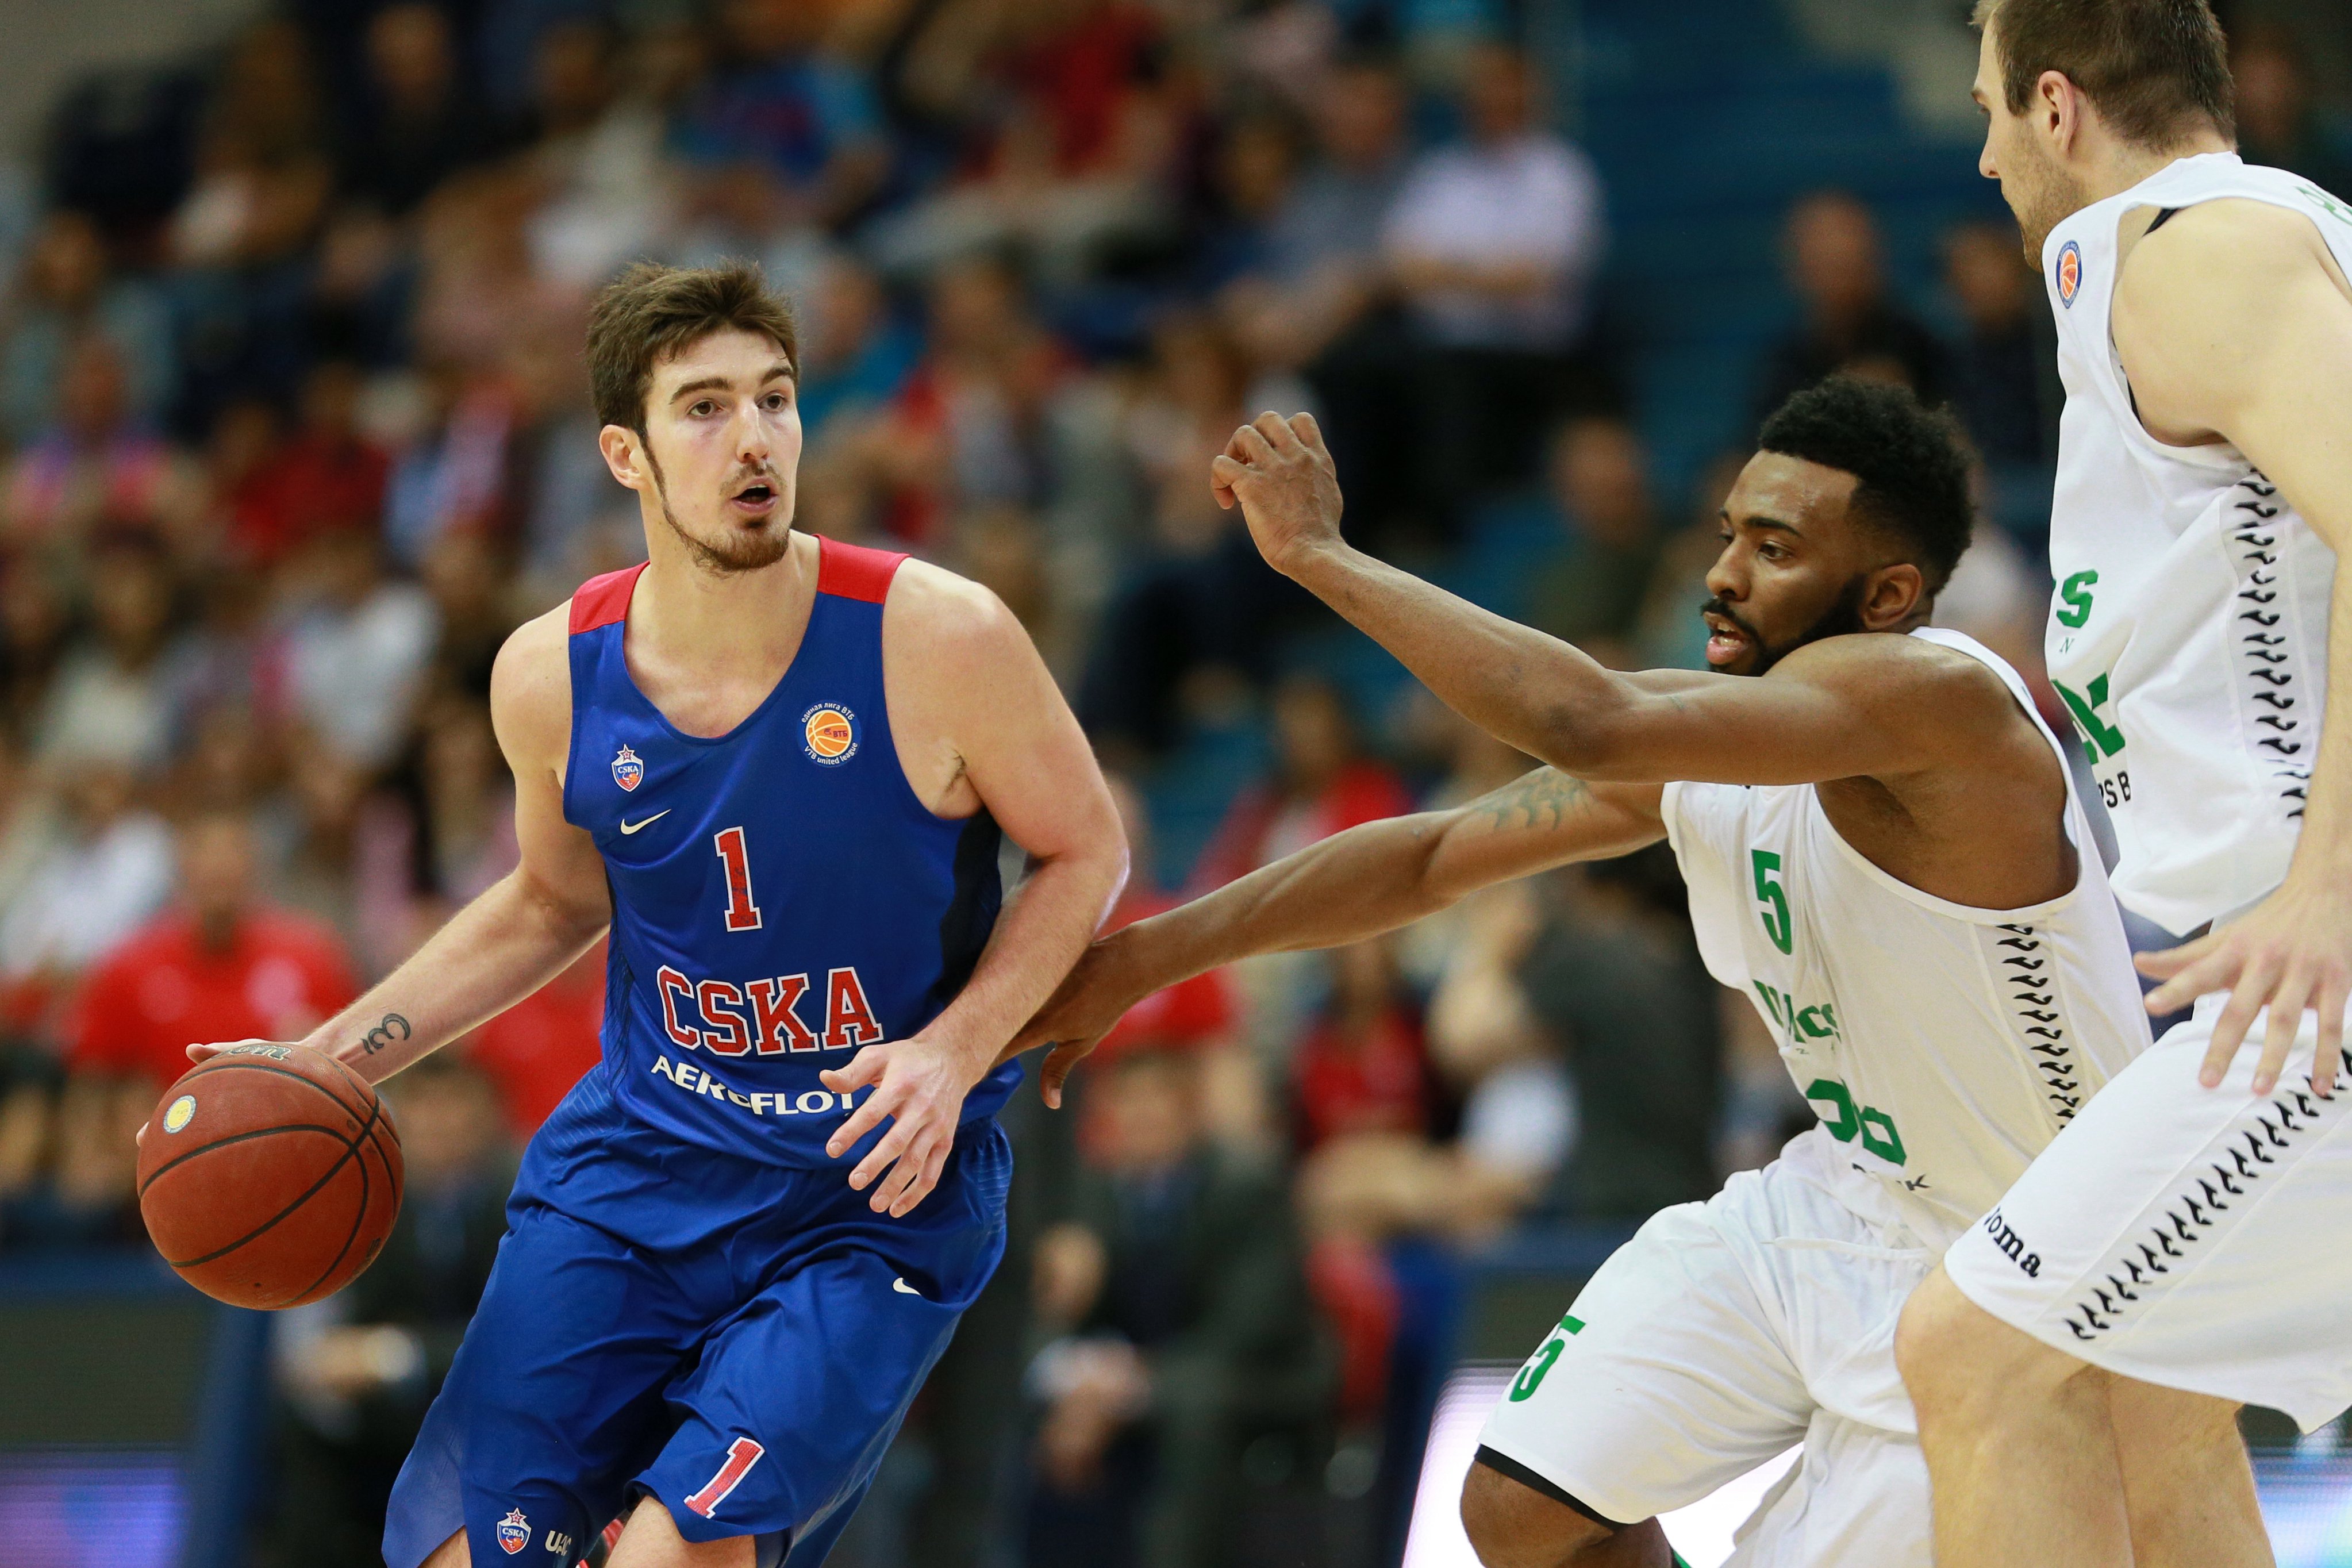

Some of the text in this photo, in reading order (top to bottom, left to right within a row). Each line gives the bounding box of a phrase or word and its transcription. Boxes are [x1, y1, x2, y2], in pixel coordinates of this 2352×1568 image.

[801, 704, 823, 722] единая
[841, 706, 855, 720] ВТБ
[617, 765, 639, 774] CSKA
[804, 743, 858, 765] VTB united league
[713, 826, 763, 932] 1
[1751, 849, 1792, 955] 5
[656, 964, 884, 1056] CSKA
[683, 1436, 765, 1519] 1
[502, 1527, 525, 1538] CSKA
